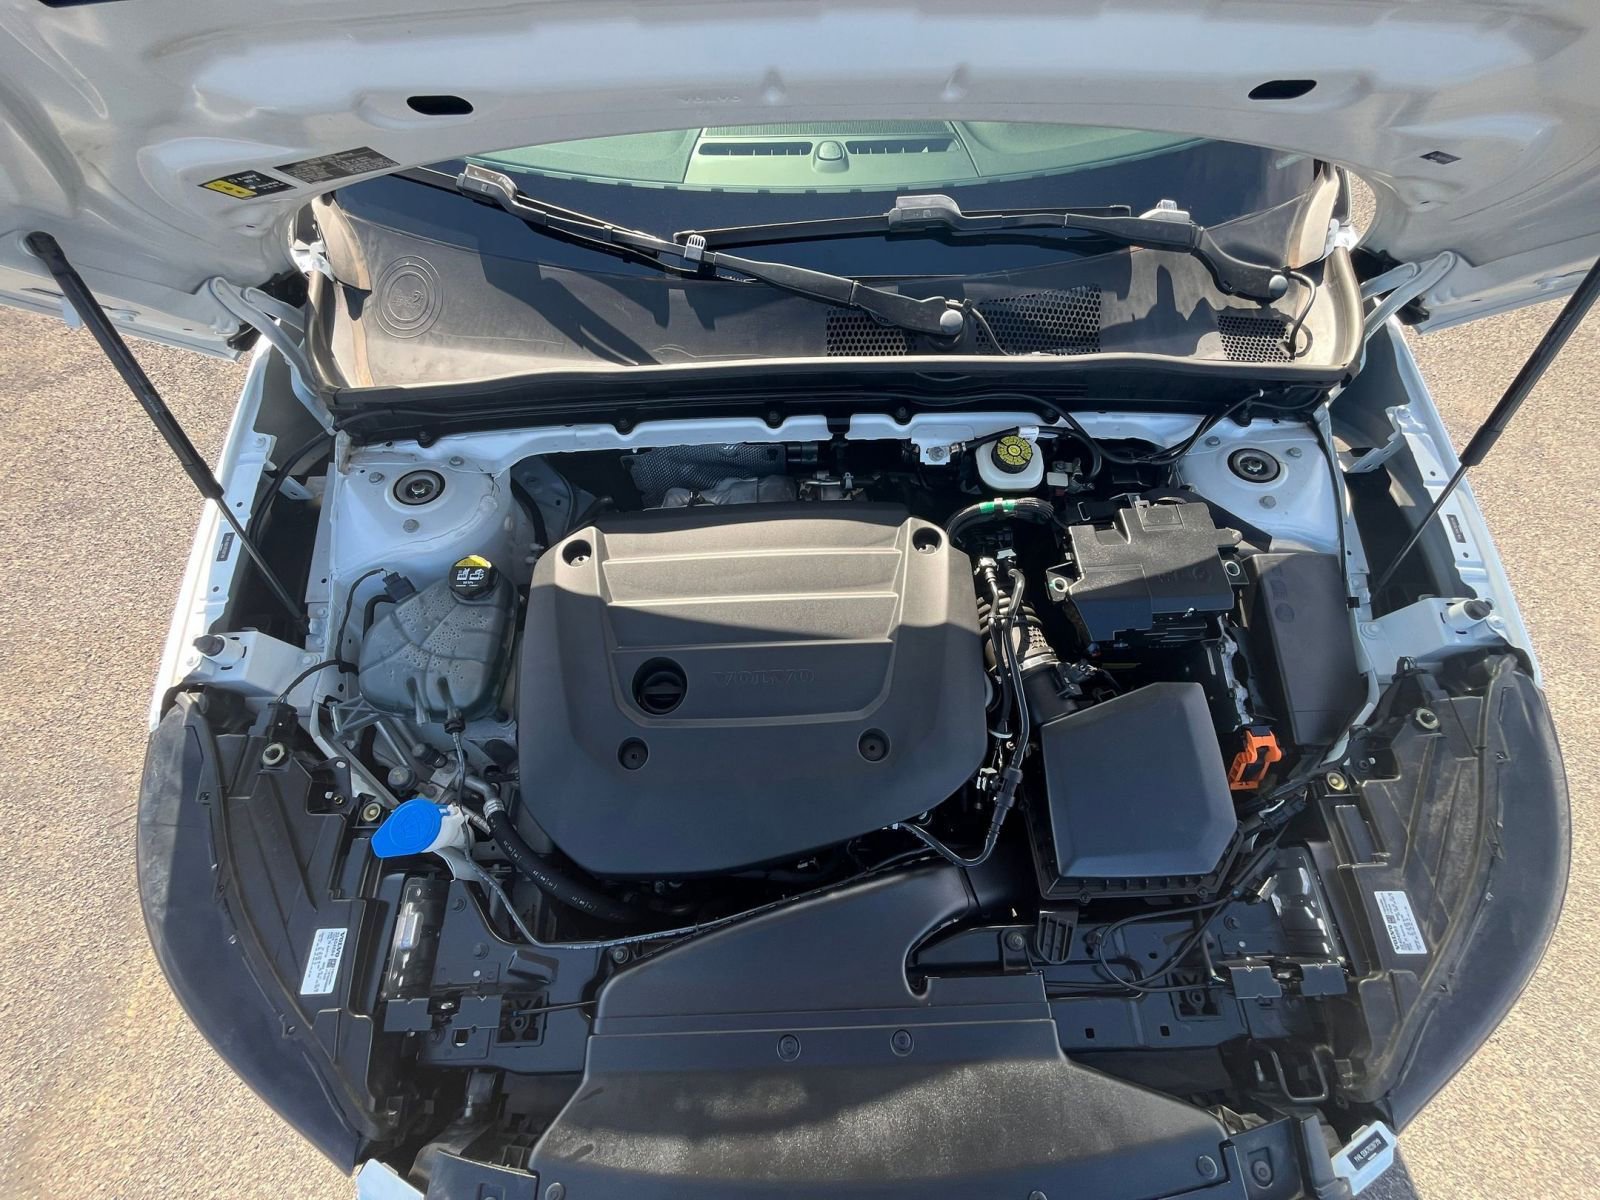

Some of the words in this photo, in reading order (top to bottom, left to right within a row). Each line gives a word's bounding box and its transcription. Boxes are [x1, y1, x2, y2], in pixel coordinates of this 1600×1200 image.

[678, 96, 742, 105] VOLVO
[711, 667, 814, 687] VOLVO
[334, 931, 346, 958] VOLVO
[1387, 924, 1400, 950] VOLVO
